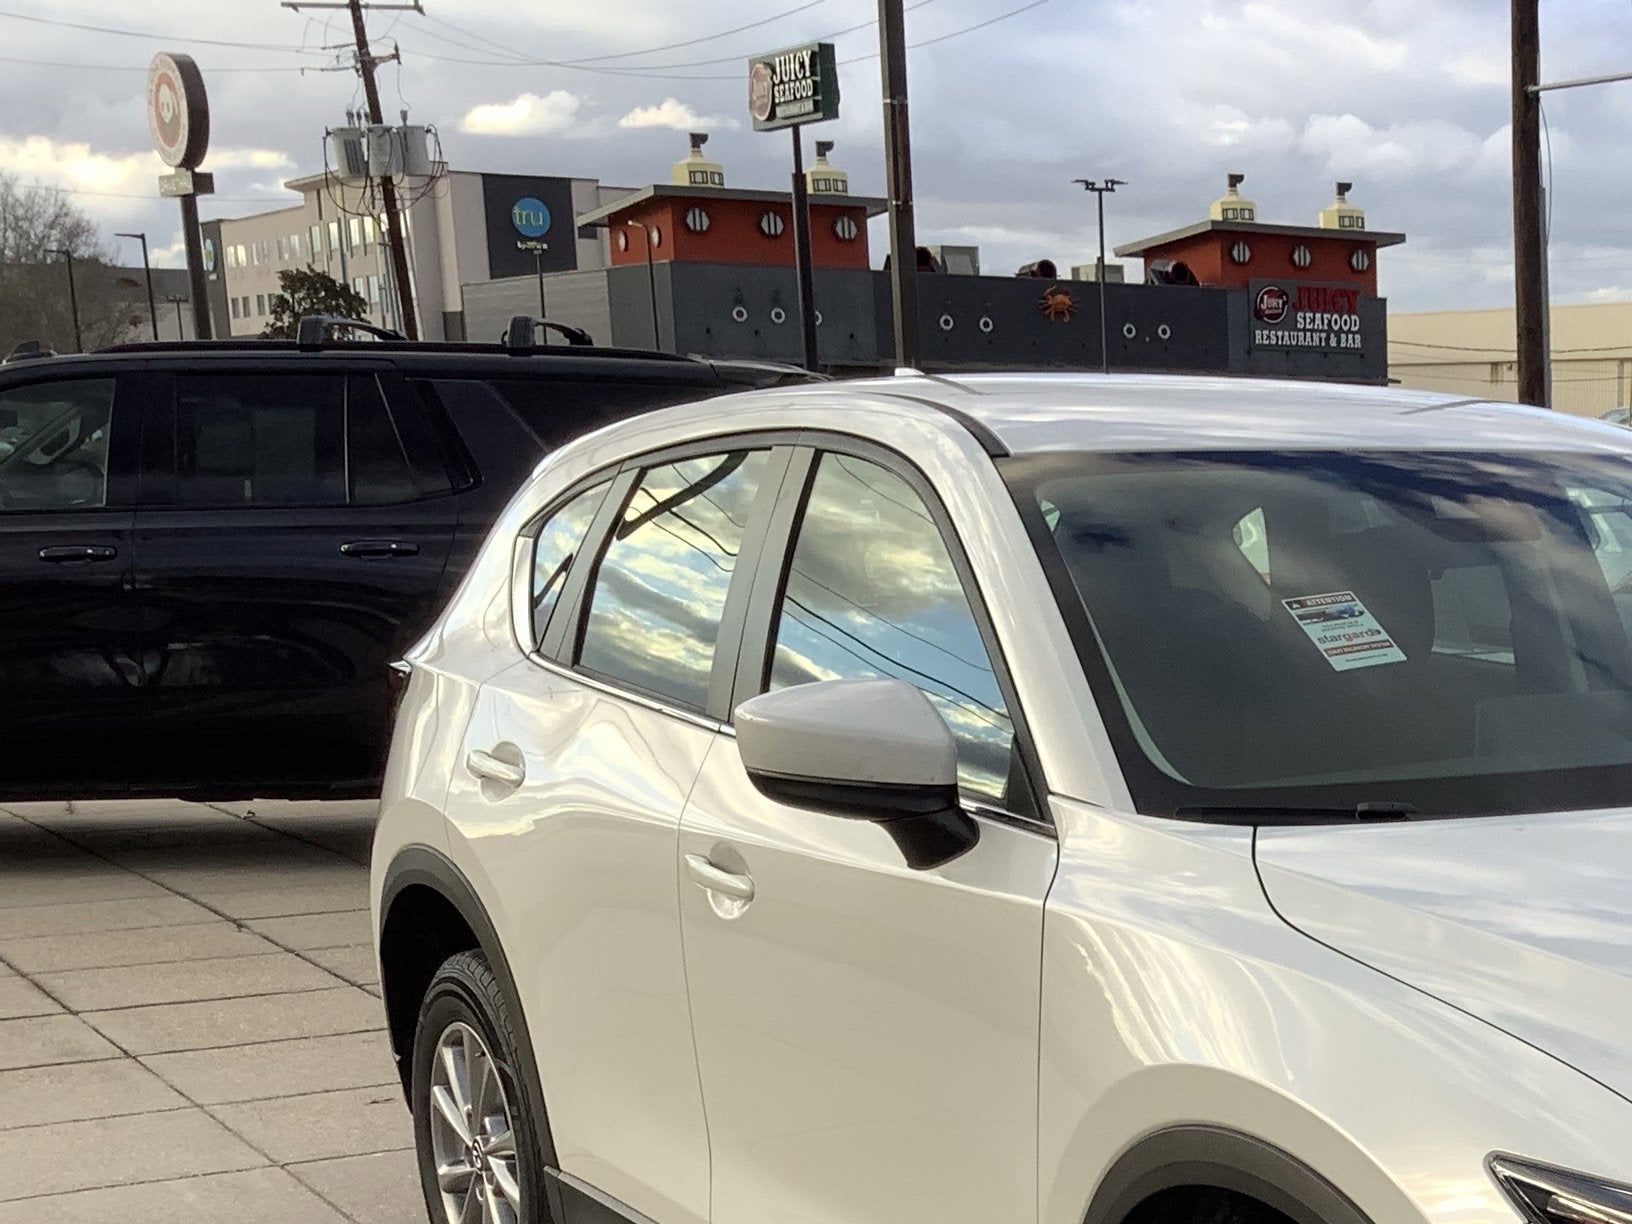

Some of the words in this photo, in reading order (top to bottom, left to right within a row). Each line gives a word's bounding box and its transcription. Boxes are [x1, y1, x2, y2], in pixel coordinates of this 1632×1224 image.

[773, 50, 811, 84] JUICY
[774, 78, 813, 103] SEAFOOD
[513, 207, 543, 226] tru
[1293, 285, 1359, 313] JUICY
[1297, 312, 1360, 331] SEAFOOD
[1255, 330, 1327, 346] RESTAURANT
[1329, 333, 1337, 347] &
[1340, 334, 1361, 348] BAR
[1306, 593, 1353, 607] ATTENTION
